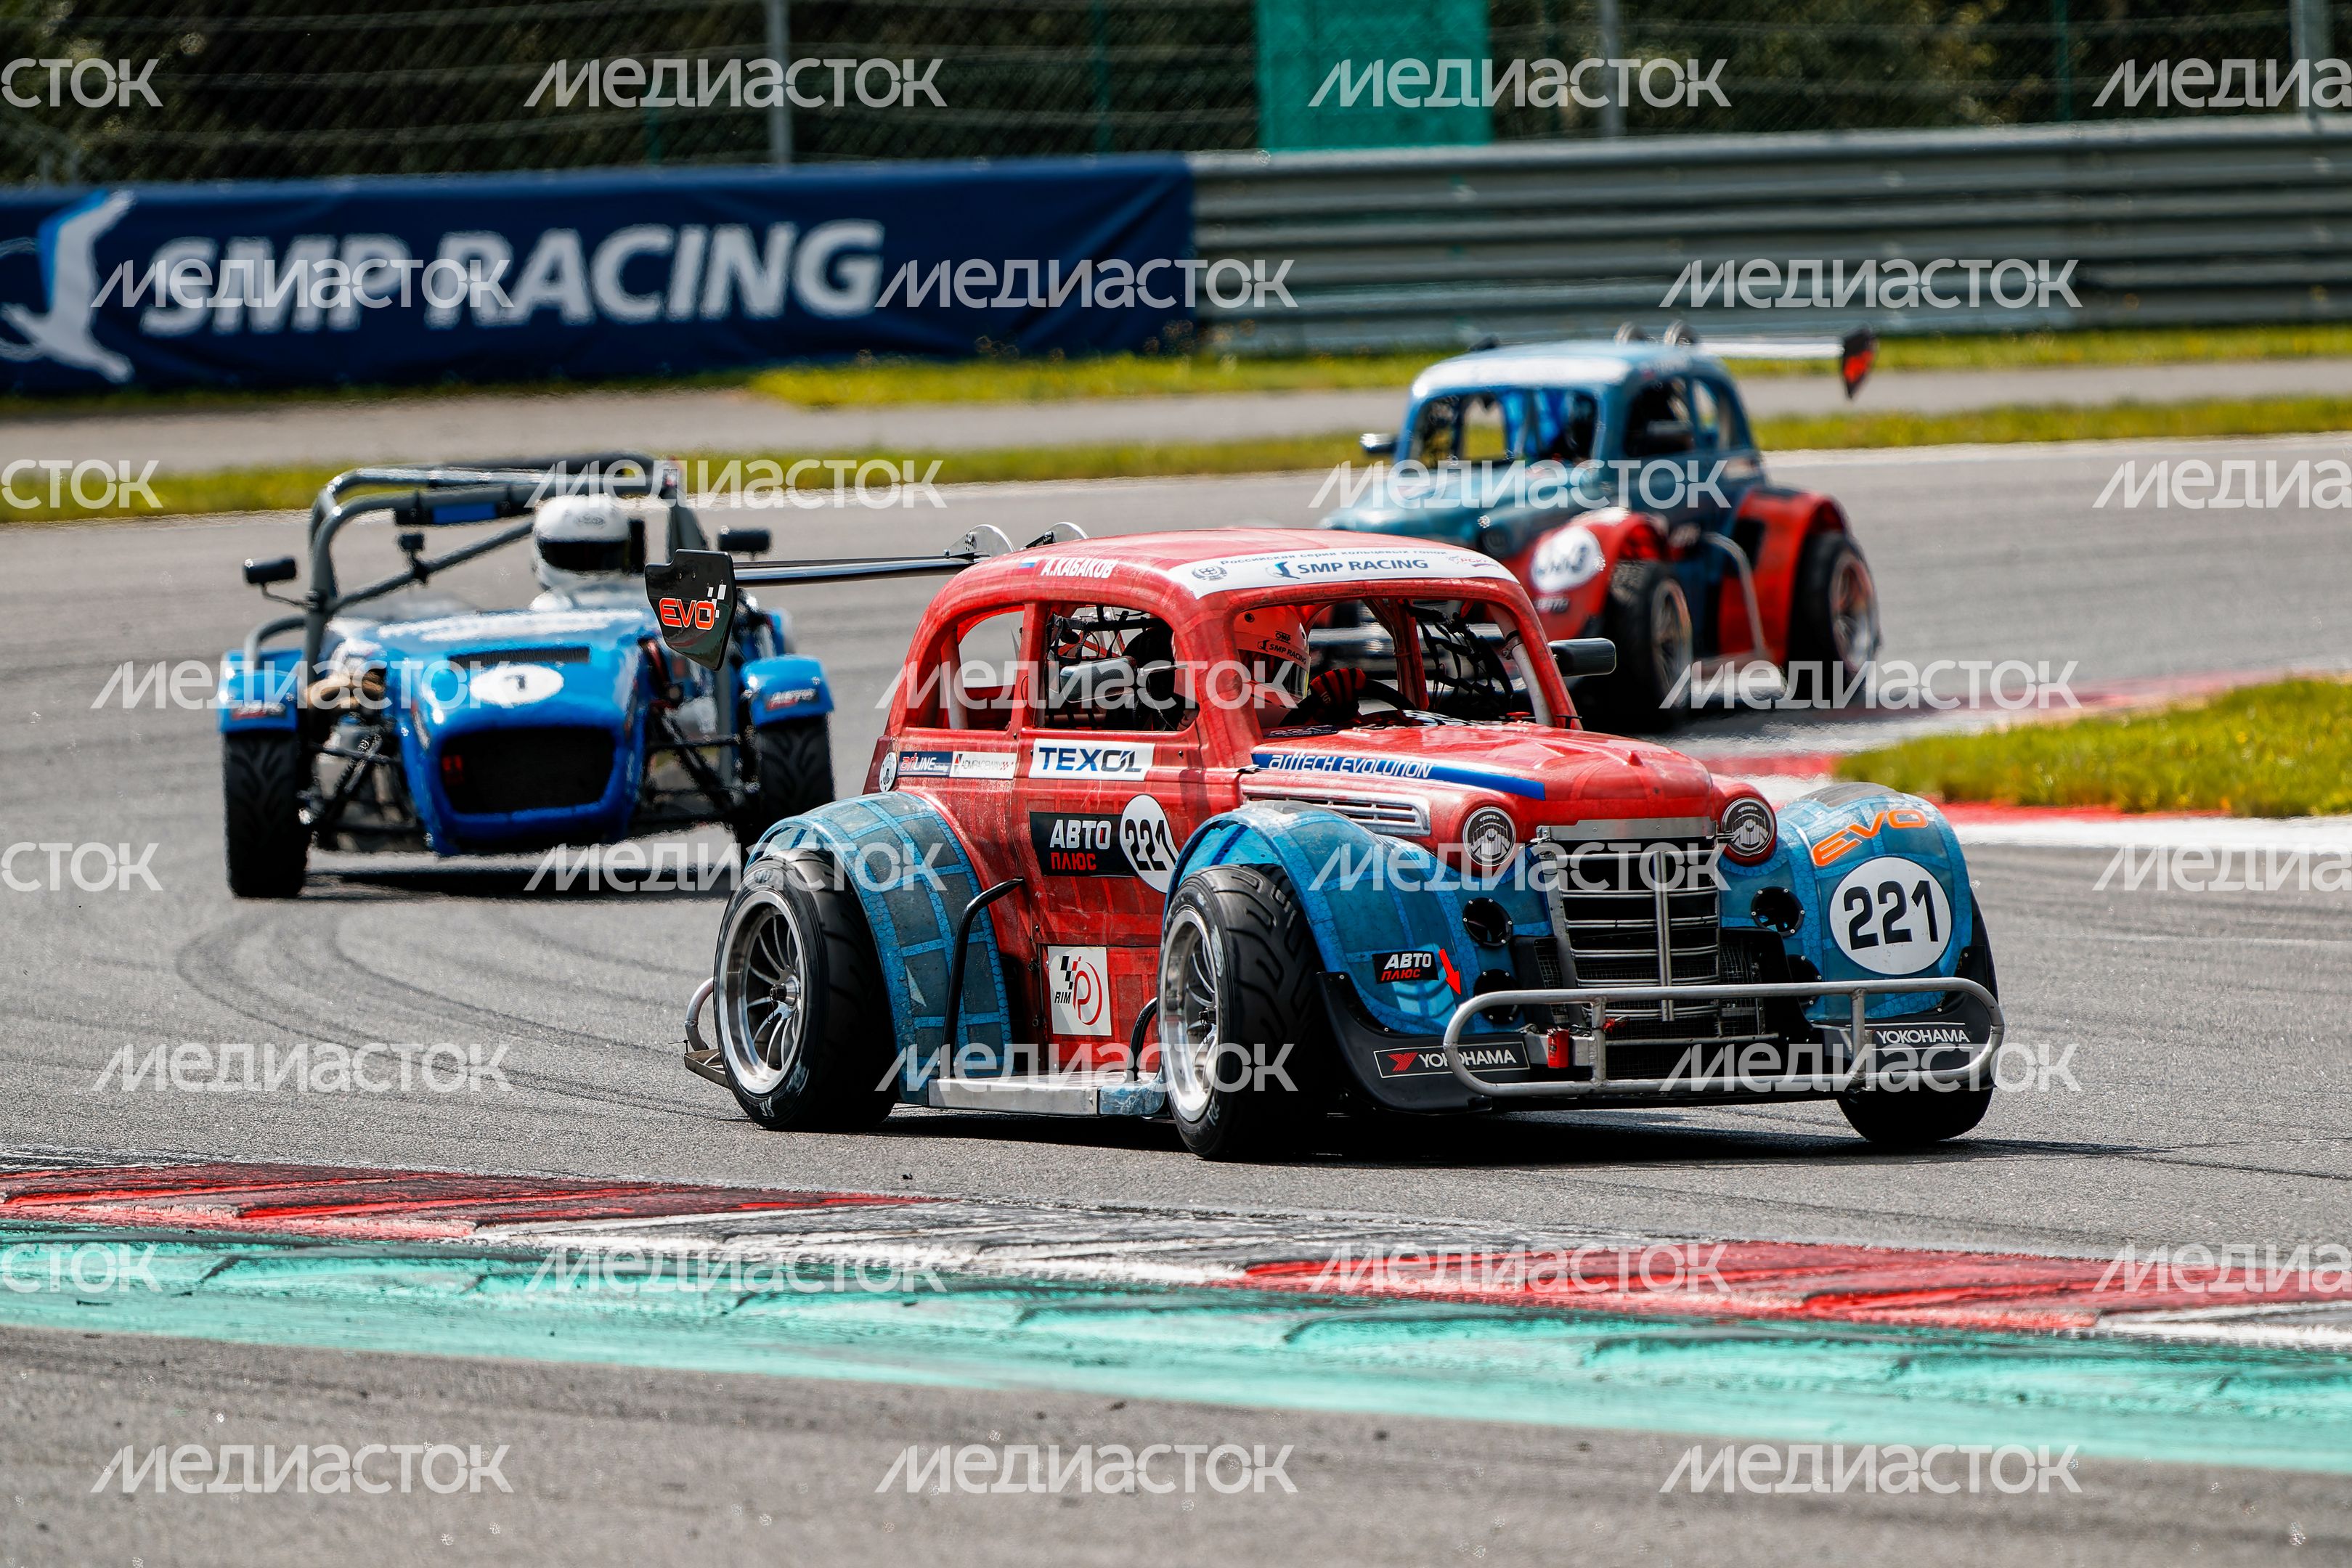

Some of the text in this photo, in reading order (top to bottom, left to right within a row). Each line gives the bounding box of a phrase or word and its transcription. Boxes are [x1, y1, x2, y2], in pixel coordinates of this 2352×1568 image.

[142, 219, 883, 335] SMP RACING
[1041, 557, 1119, 579] А.КАБАКОВ
[1297, 559, 1429, 574] SMP RACING
[659, 597, 715, 631] EVO
[1275, 631, 1291, 643] OMP
[1269, 643, 1307, 664] SMP RACING
[1039, 747, 1142, 772] TEXOL
[1049, 819, 1112, 849] АВТО
[1810, 809, 1929, 867] EVO
[1126, 819, 1177, 871] 221
[1051, 852, 1097, 870] ПЛЮС
[1843, 880, 1939, 951] 221
[1383, 953, 1432, 970] АВТО
[1380, 968, 1421, 981] ПЛЮС
[1054, 991, 1072, 1004] RIM
[1876, 1029, 1971, 1044] YOKOHAMA
